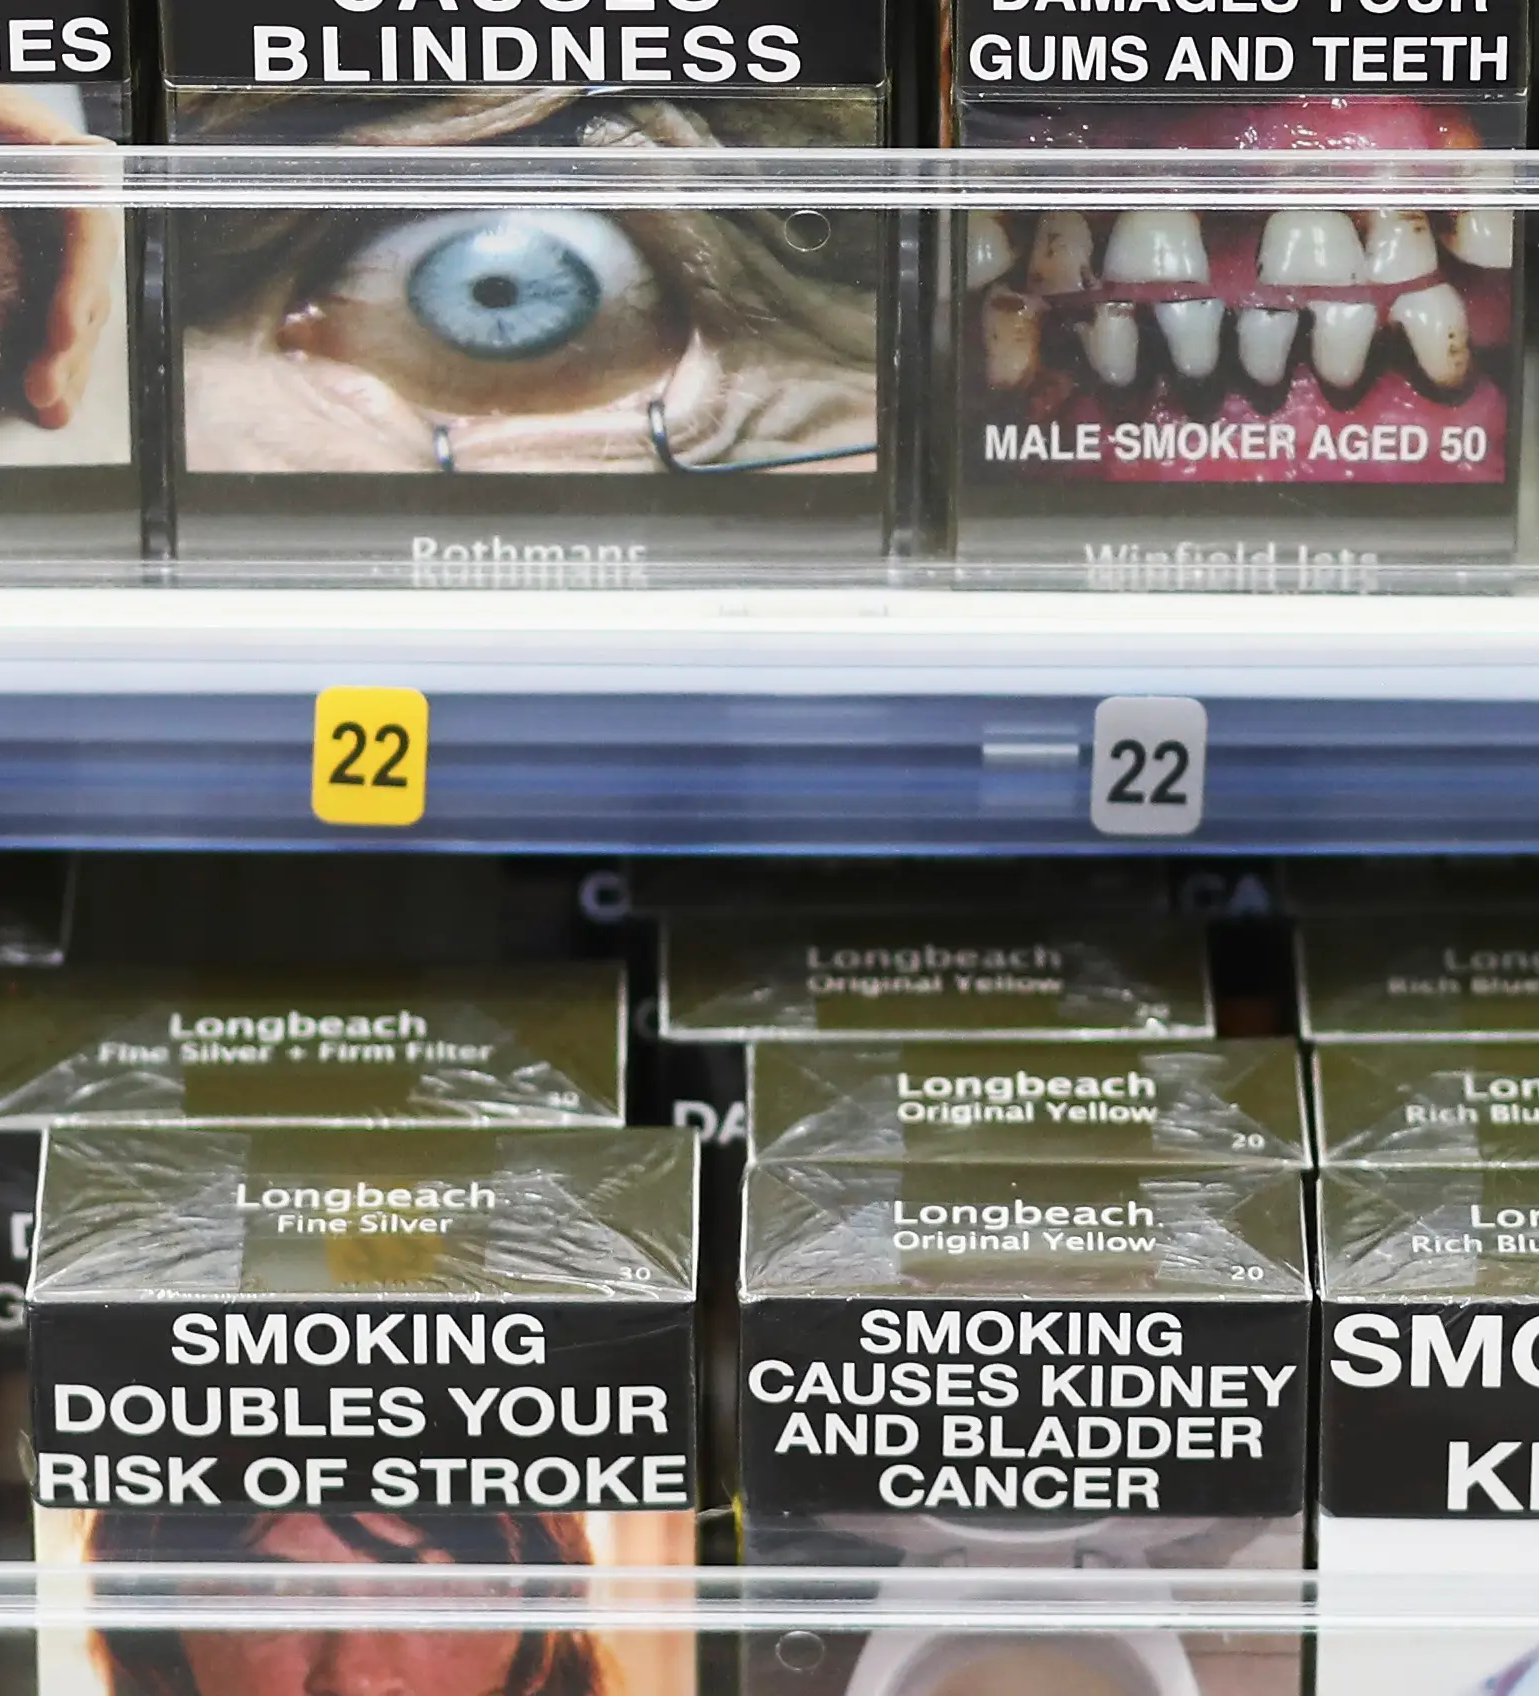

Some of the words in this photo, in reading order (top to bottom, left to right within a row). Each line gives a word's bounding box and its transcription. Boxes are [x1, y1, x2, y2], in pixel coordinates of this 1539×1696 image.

[254, 25, 800, 82] BLINDNESS
[329, 722, 409, 788] 22
[1108, 740, 1188, 805] 22
[169, 1011, 426, 1039] Longbeach
[99, 1043, 168, 1063] Fine
[181, 1042, 271, 1062] Silver
[319, 1042, 394, 1060] Firm
[406, 1042, 491, 1060] Filter
[231, 1182, 495, 1214] Longbeach
[278, 1215, 352, 1232] Fine
[360, 1211, 453, 1233] Silver
[619, 1267, 650, 1280] 30
